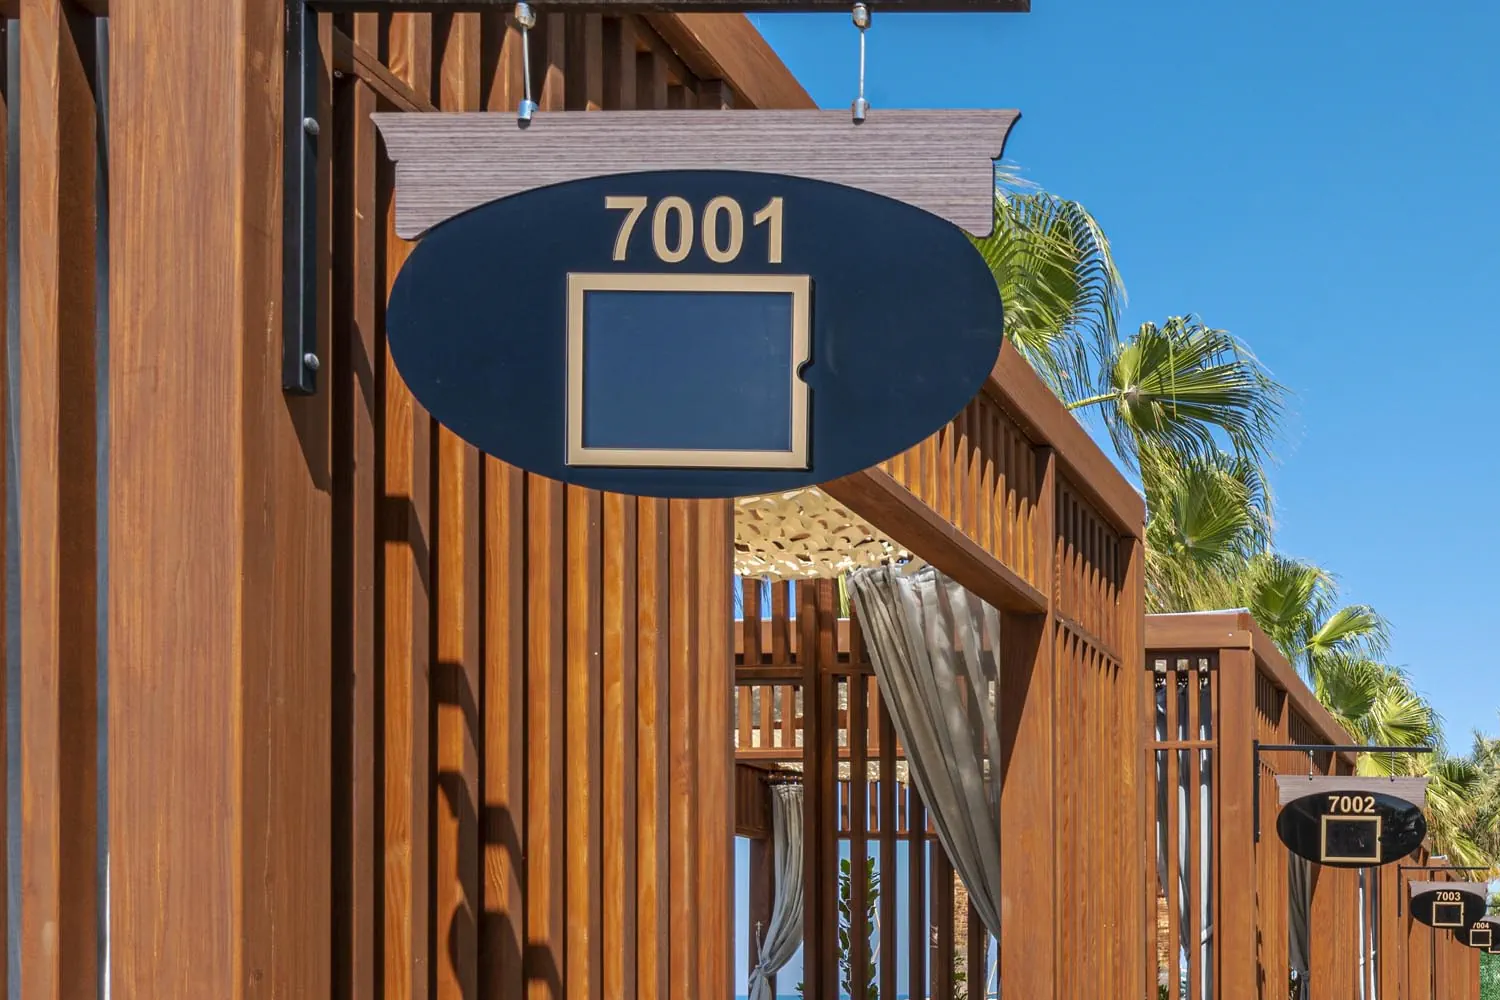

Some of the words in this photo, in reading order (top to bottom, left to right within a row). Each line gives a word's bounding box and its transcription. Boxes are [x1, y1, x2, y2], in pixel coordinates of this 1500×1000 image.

[604, 195, 784, 264] 7001
[1328, 795, 1375, 813] 7002
[1436, 891, 1461, 901] 7003
